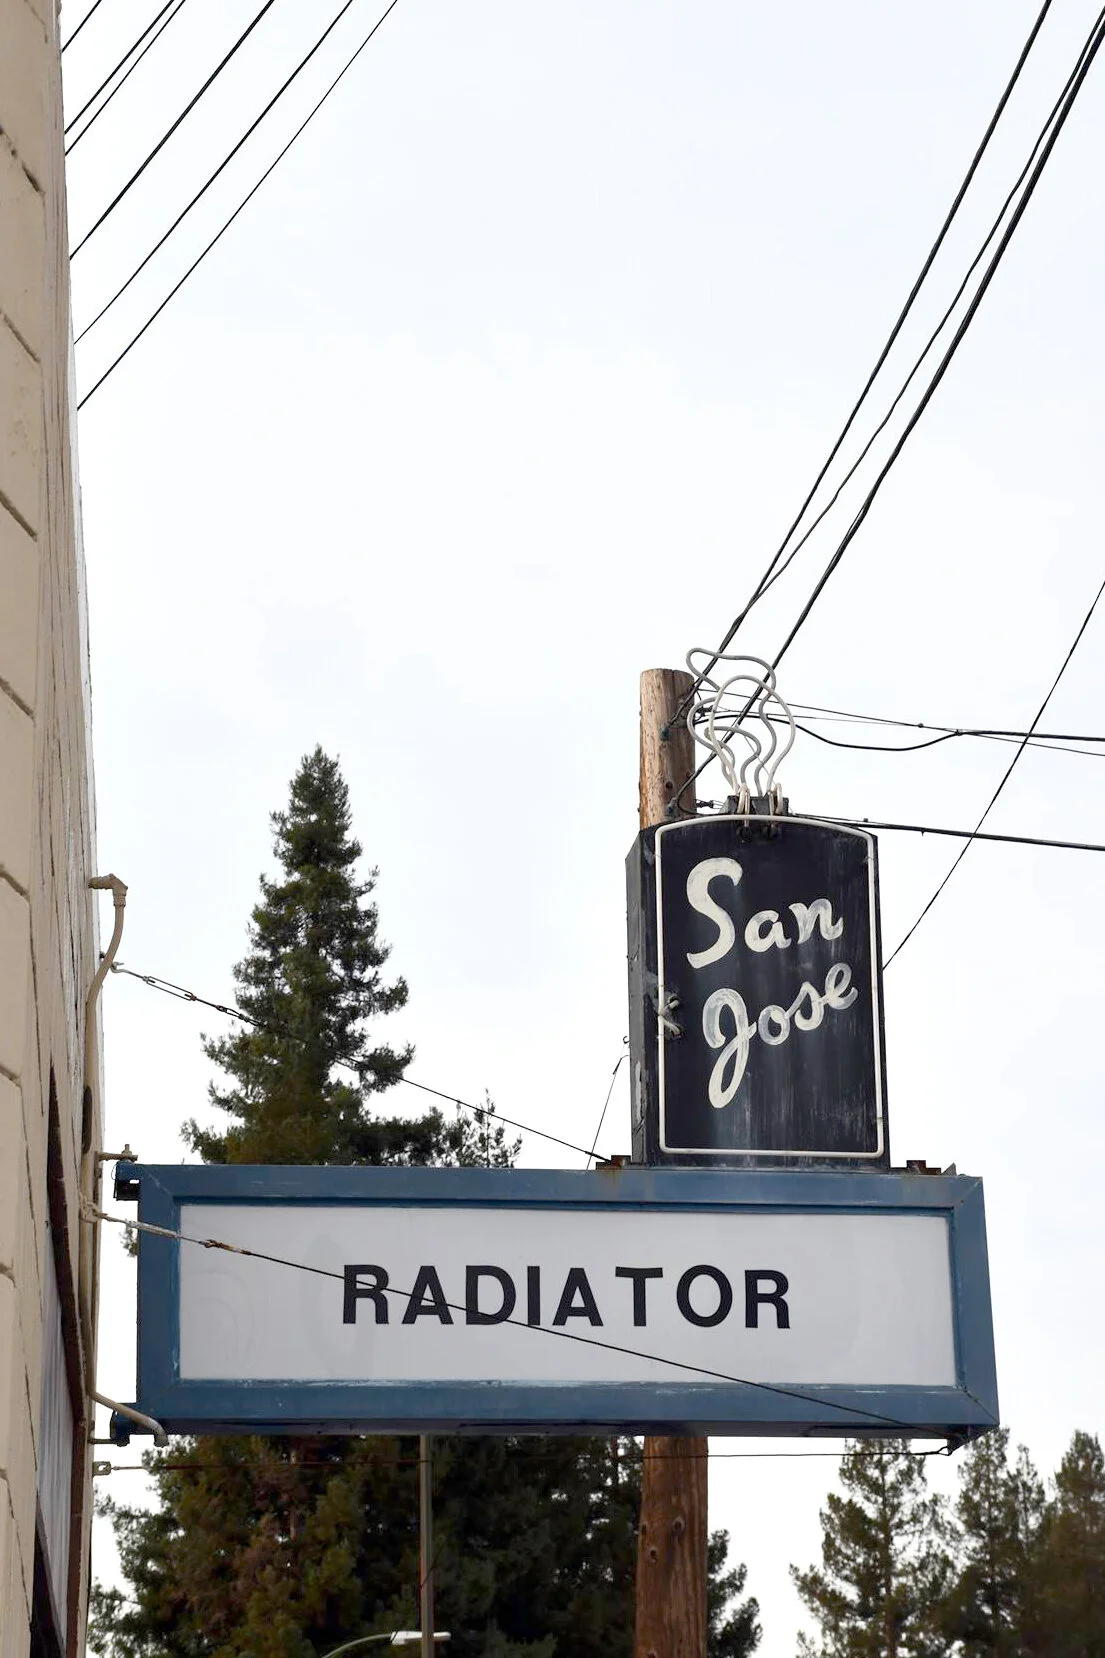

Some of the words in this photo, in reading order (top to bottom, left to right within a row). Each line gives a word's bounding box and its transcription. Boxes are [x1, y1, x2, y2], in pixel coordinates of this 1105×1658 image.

[686, 857, 844, 969] San
[702, 962, 858, 1109] Jose
[342, 1264, 791, 1329] RADIATOR
